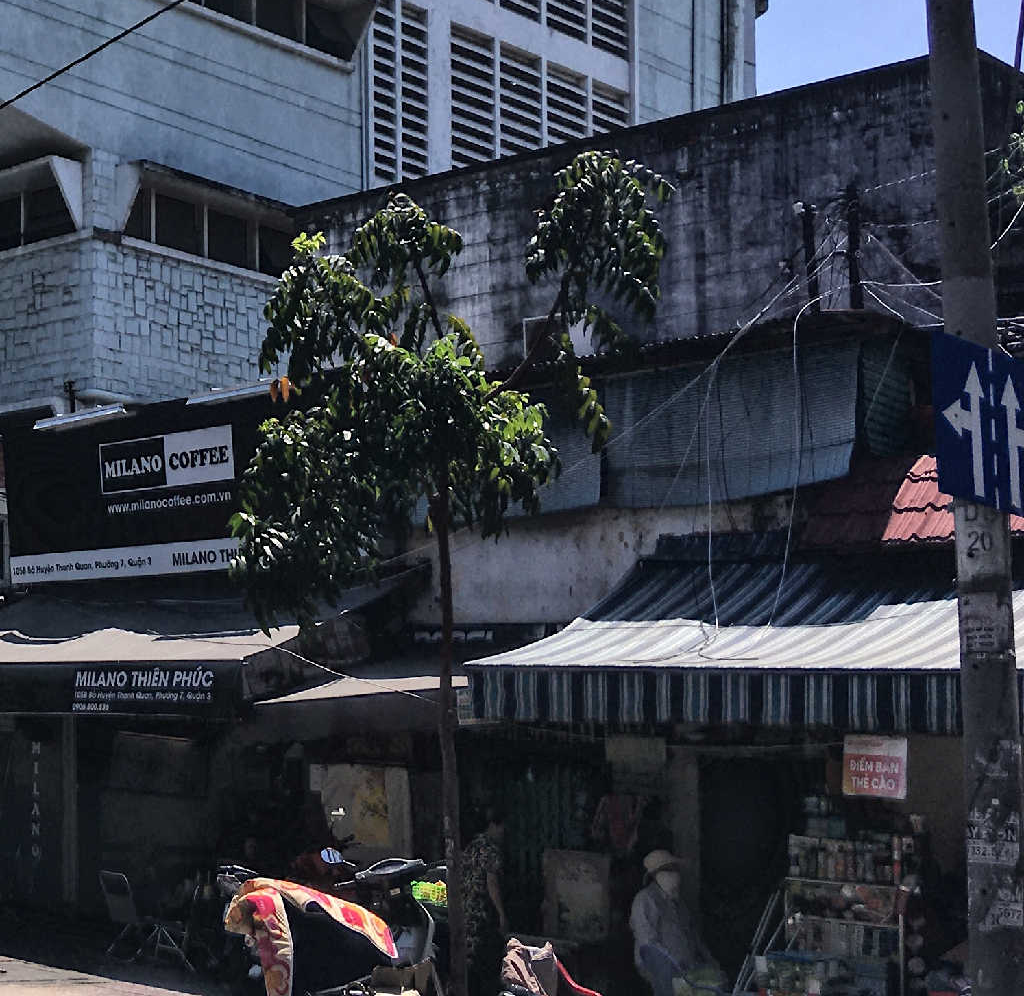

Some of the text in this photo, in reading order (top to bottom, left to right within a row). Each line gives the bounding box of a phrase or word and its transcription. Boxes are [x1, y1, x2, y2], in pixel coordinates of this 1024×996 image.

[104, 445, 229, 479] MILANO COFFEE
[107, 490, 232, 514] www.milanocoffee.com.vn
[968, 531, 993, 553] 20
[56, 562, 74, 573] Thanh
[127, 557, 146, 568] Quận
[147, 556, 152, 566] 3
[172, 550, 217, 567] MILANO
[75, 665, 215, 687] MILANO THIÊN PHÚC
[116, 691, 135, 700] Thanh
[206, 692, 212, 700] 3
[871, 774, 896, 791] CÀO
[31, 741, 42, 857] MILANO
